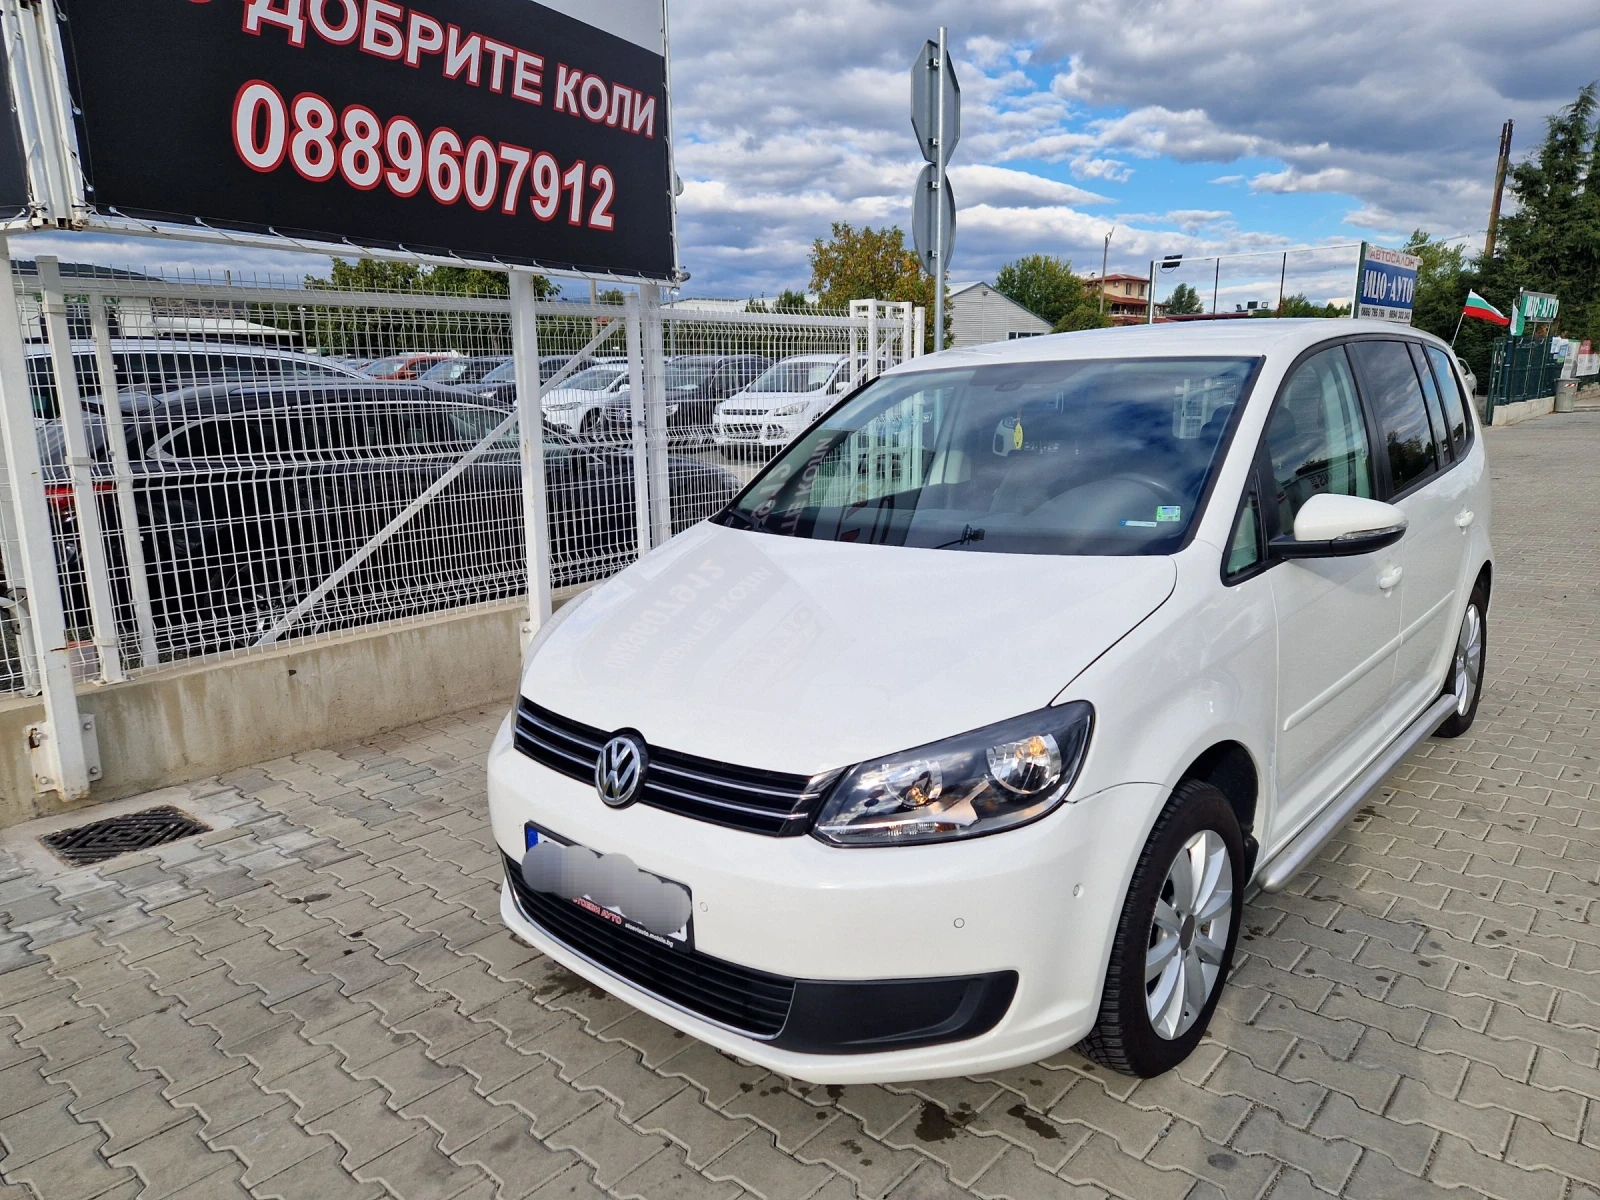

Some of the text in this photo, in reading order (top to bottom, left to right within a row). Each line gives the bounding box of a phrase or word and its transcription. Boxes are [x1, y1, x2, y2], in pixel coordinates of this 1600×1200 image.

[242, 0, 656, 138] ДОБРИТЕ КОЛИ
[232, 79, 616, 231] 0889607912
[1363, 269, 1414, 304] ИЦО-АУТО
[1370, 250, 1415, 267] АВТОСАЛОН
